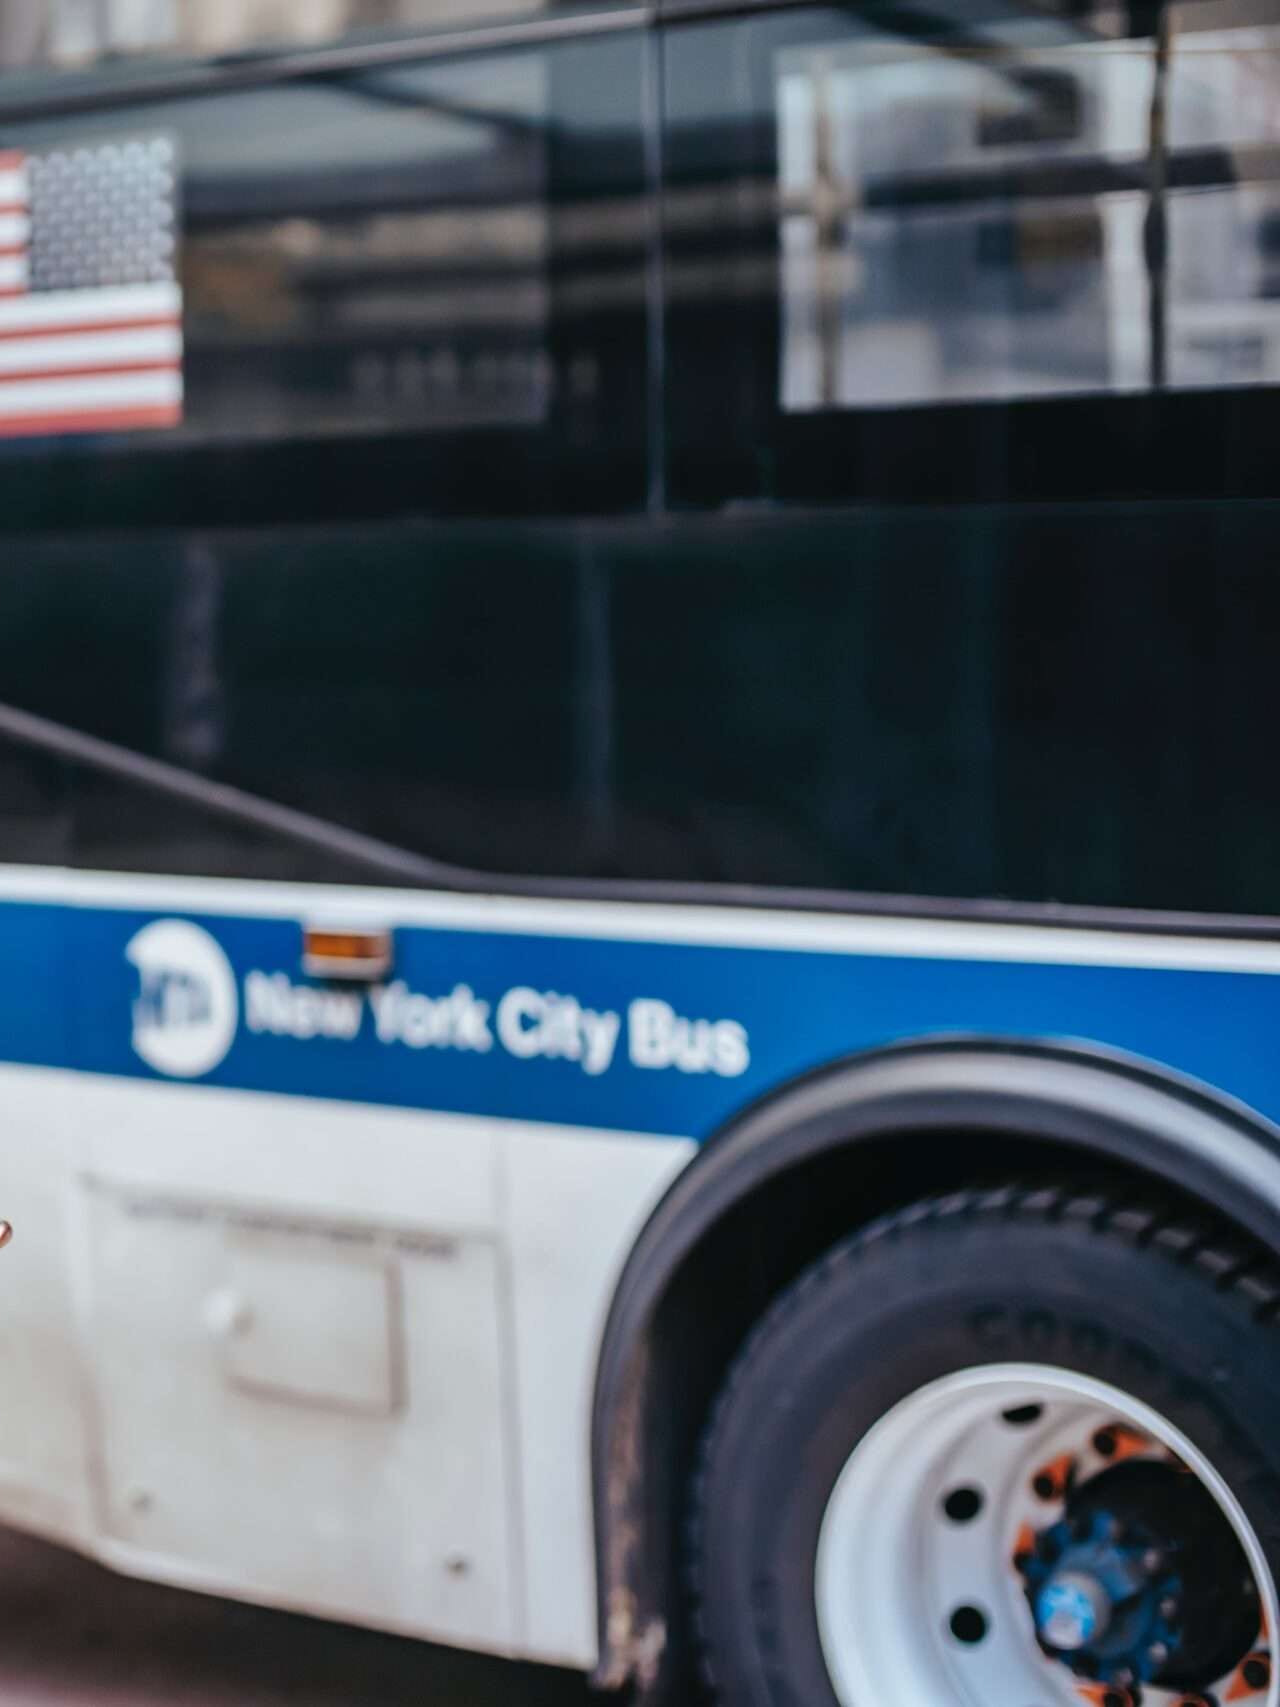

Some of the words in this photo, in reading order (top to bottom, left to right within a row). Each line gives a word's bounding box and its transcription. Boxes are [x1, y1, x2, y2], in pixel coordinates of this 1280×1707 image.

[244, 969, 363, 1040] New
[369, 980, 492, 1052] York
[496, 986, 619, 1075] City
[627, 998, 751, 1077] Bus
